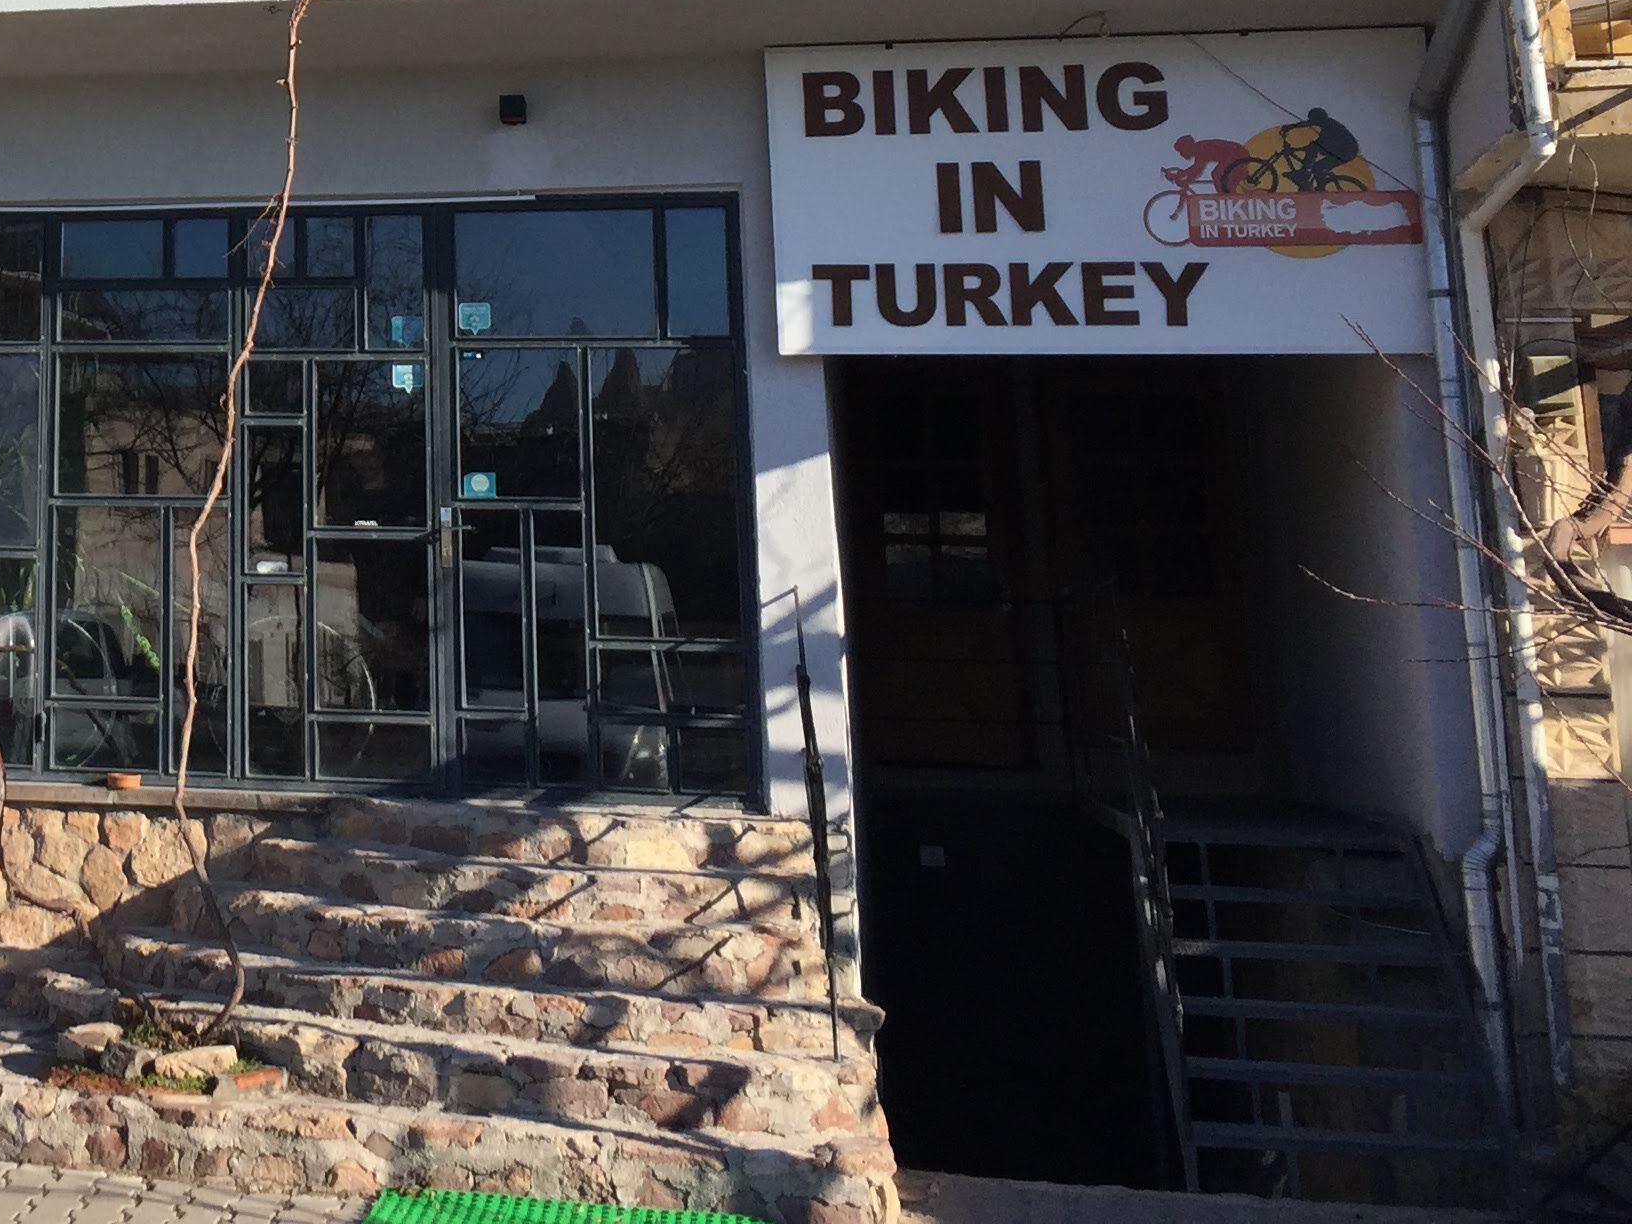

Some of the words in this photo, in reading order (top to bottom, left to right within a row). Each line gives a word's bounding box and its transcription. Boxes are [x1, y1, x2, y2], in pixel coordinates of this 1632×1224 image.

[801, 62, 1170, 138] BIKING
[934, 160, 1046, 234] IN
[1199, 198, 1297, 222] BIKING
[1200, 224, 1219, 238] IN
[1223, 223, 1298, 238] TURKEY
[811, 261, 1210, 327] TURKEY
